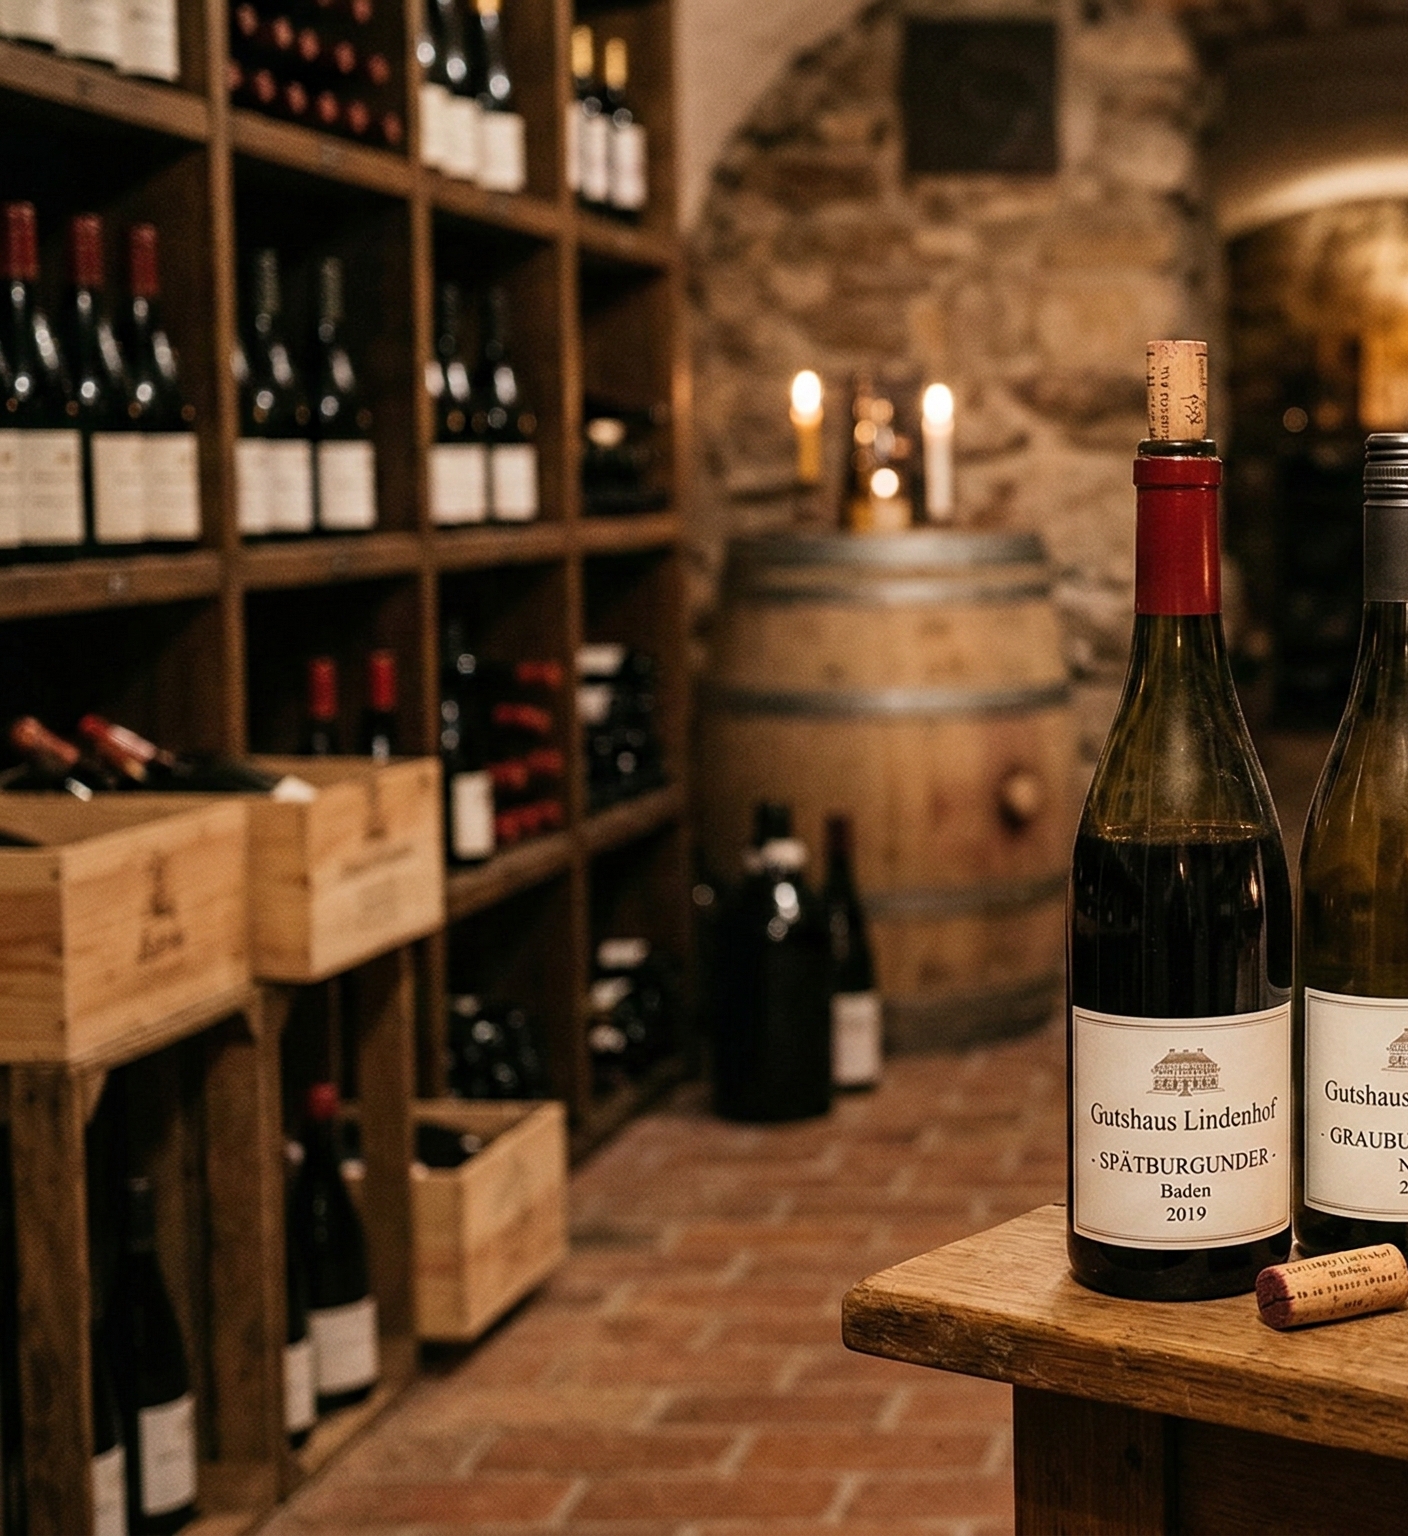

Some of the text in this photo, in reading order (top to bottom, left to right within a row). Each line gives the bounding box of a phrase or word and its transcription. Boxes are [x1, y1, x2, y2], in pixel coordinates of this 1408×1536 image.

[1091, 1096, 1278, 1131] Gutshaus Lindenhof
[1099, 1148, 1269, 1175] SPÄTBURGUNDER
[1160, 1183, 1212, 1199] Baden
[1166, 1206, 1207, 1222] 2019
